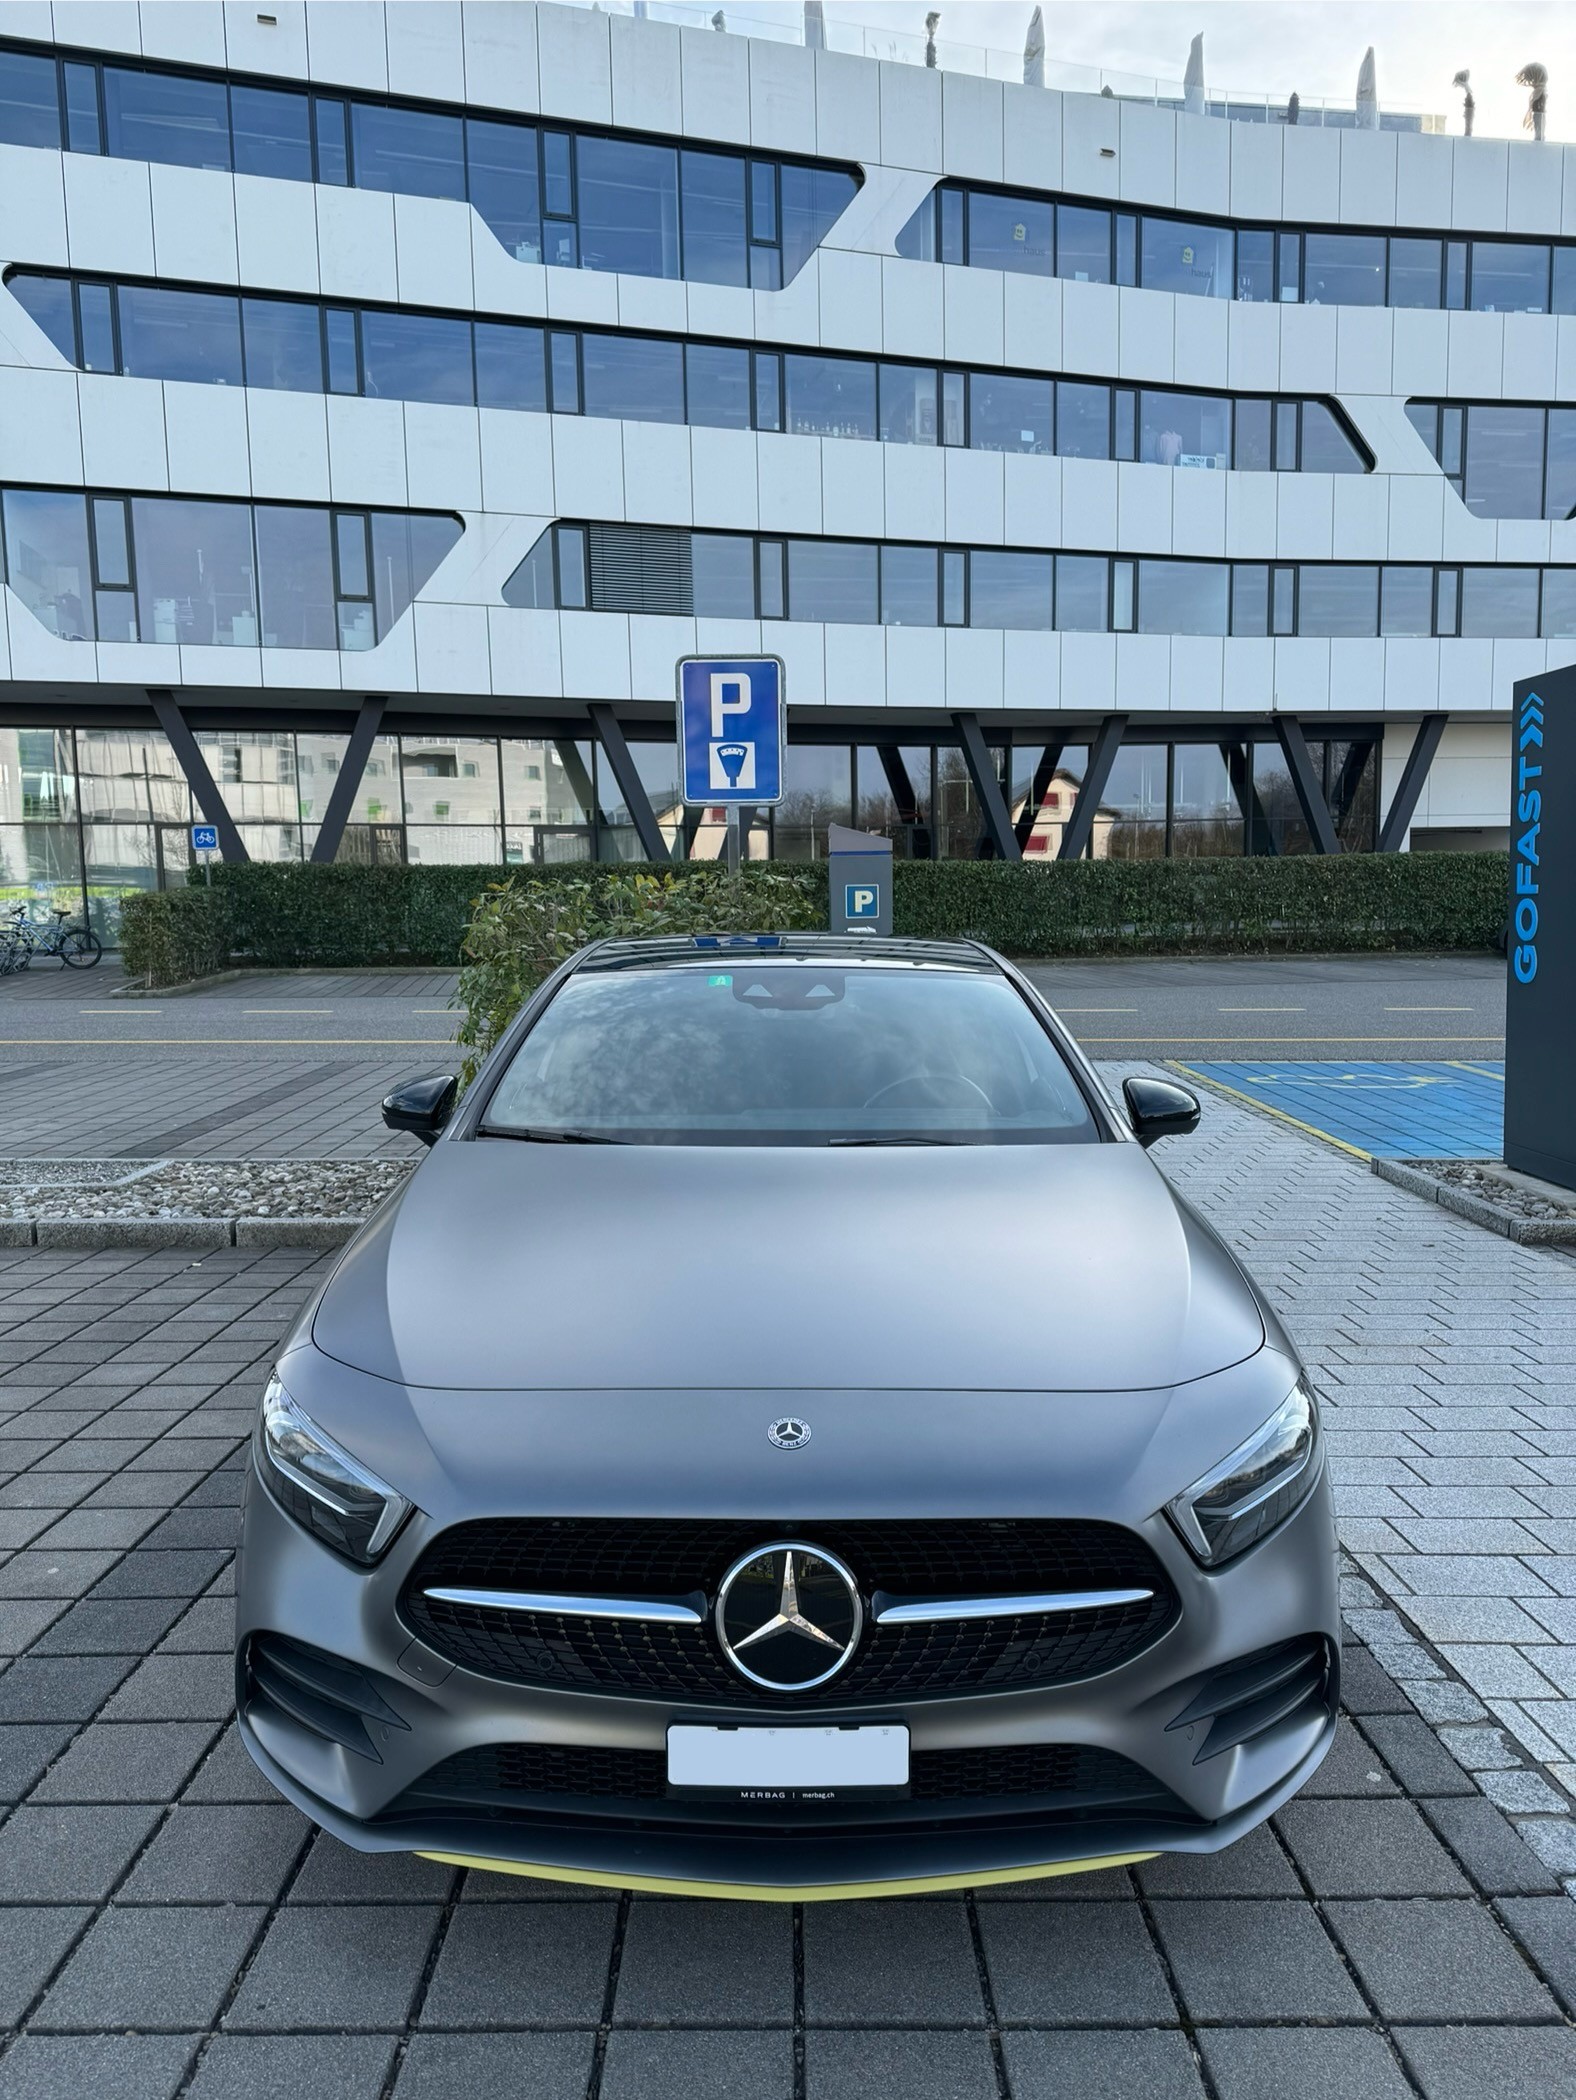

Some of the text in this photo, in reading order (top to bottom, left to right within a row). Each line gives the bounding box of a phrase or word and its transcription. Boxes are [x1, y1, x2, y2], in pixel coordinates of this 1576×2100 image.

[710, 673, 751, 738] P
[1514, 756, 1543, 984] GOFAST
[854, 890, 874, 913] P
[740, 1791, 835, 1799] MERBAG merbag.ch
